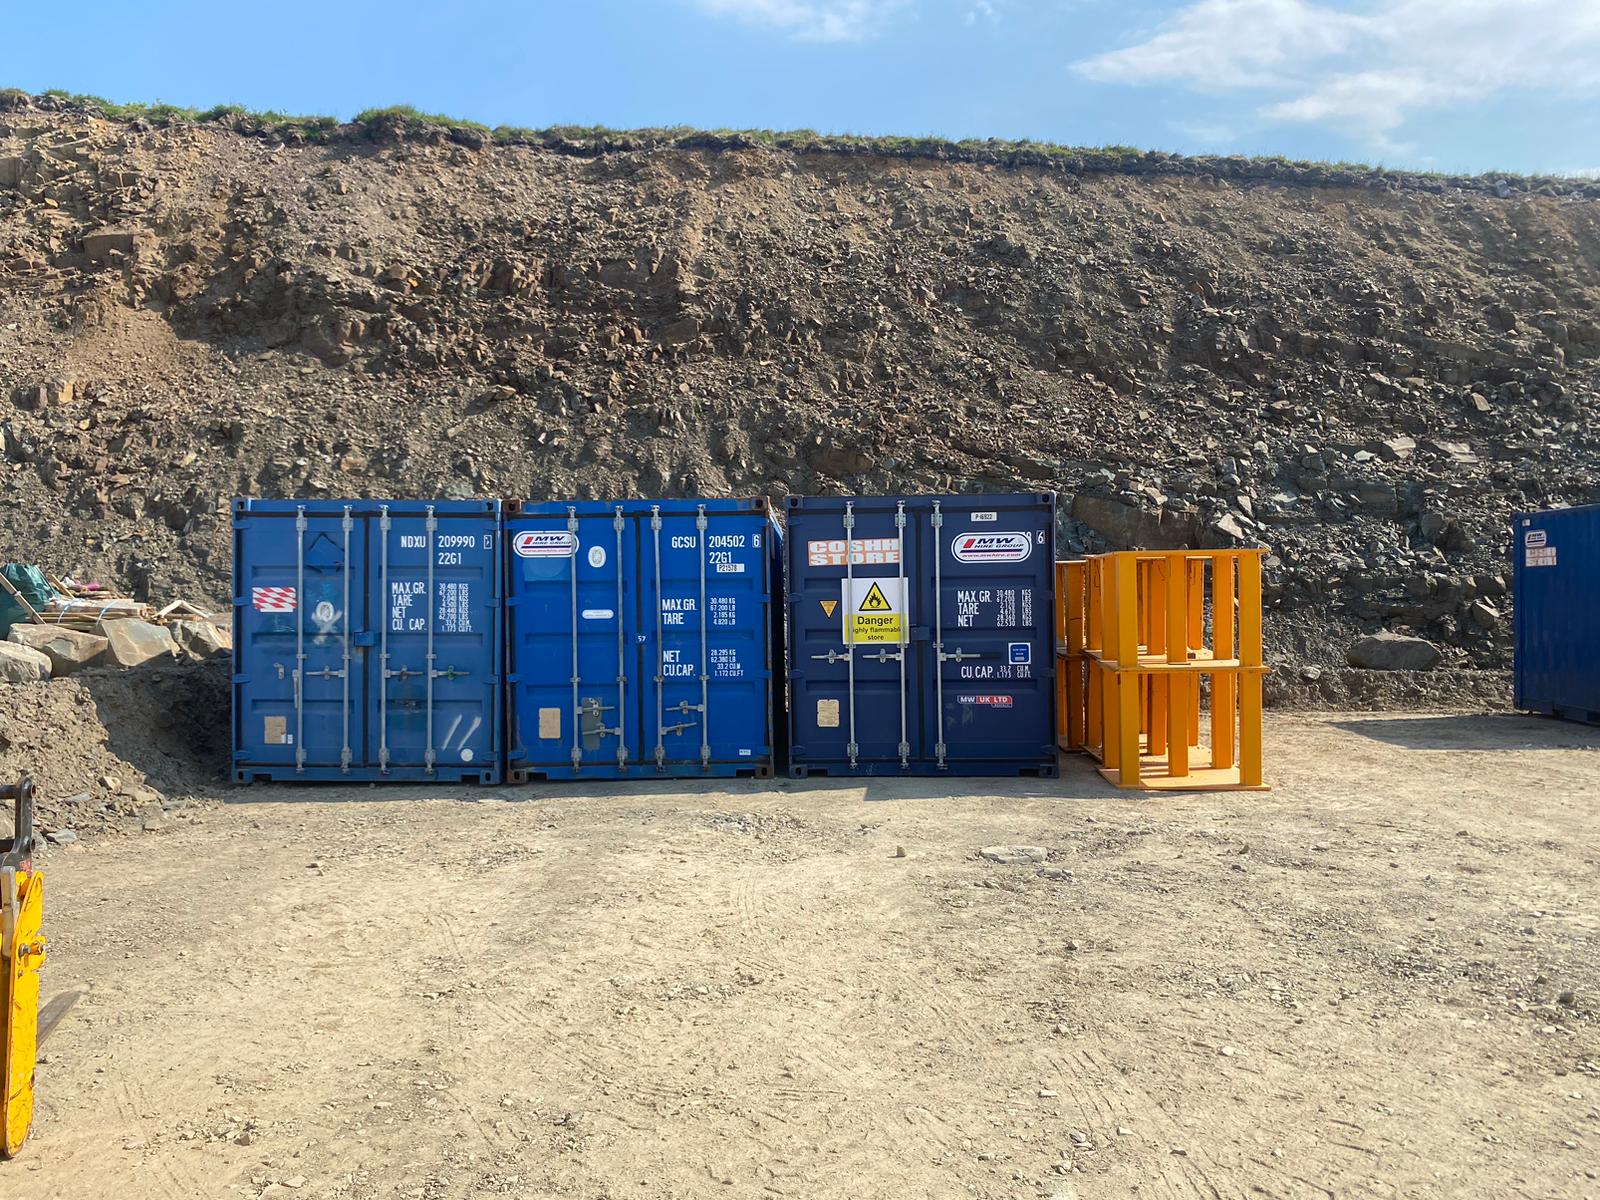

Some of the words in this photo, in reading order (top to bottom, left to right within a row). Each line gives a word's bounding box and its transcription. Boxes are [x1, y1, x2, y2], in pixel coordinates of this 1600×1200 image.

[401, 536, 426, 548] NDXU
[438, 536, 475, 548] 209990
[672, 536, 696, 548] GCSU
[708, 536, 744, 548] 204502
[753, 536, 760, 547] 6
[1037, 531, 1044, 544] 6
[809, 538, 899, 552] COSHH
[438, 552, 461, 564] 22G1
[709, 552, 732, 564] 22G1
[810, 552, 899, 566] STORE
[392, 582, 426, 594] MAX.GR.
[392, 595, 412, 606] TARE
[662, 599, 696, 610] MAX.GR.
[392, 607, 406, 618] NET
[958, 602, 980, 614] TARE
[662, 612, 684, 624] TARE
[857, 616, 894, 626] Danger
[958, 614, 974, 626] NET
[663, 650, 680, 662] NET
[663, 664, 696, 676] CU.CAP.
